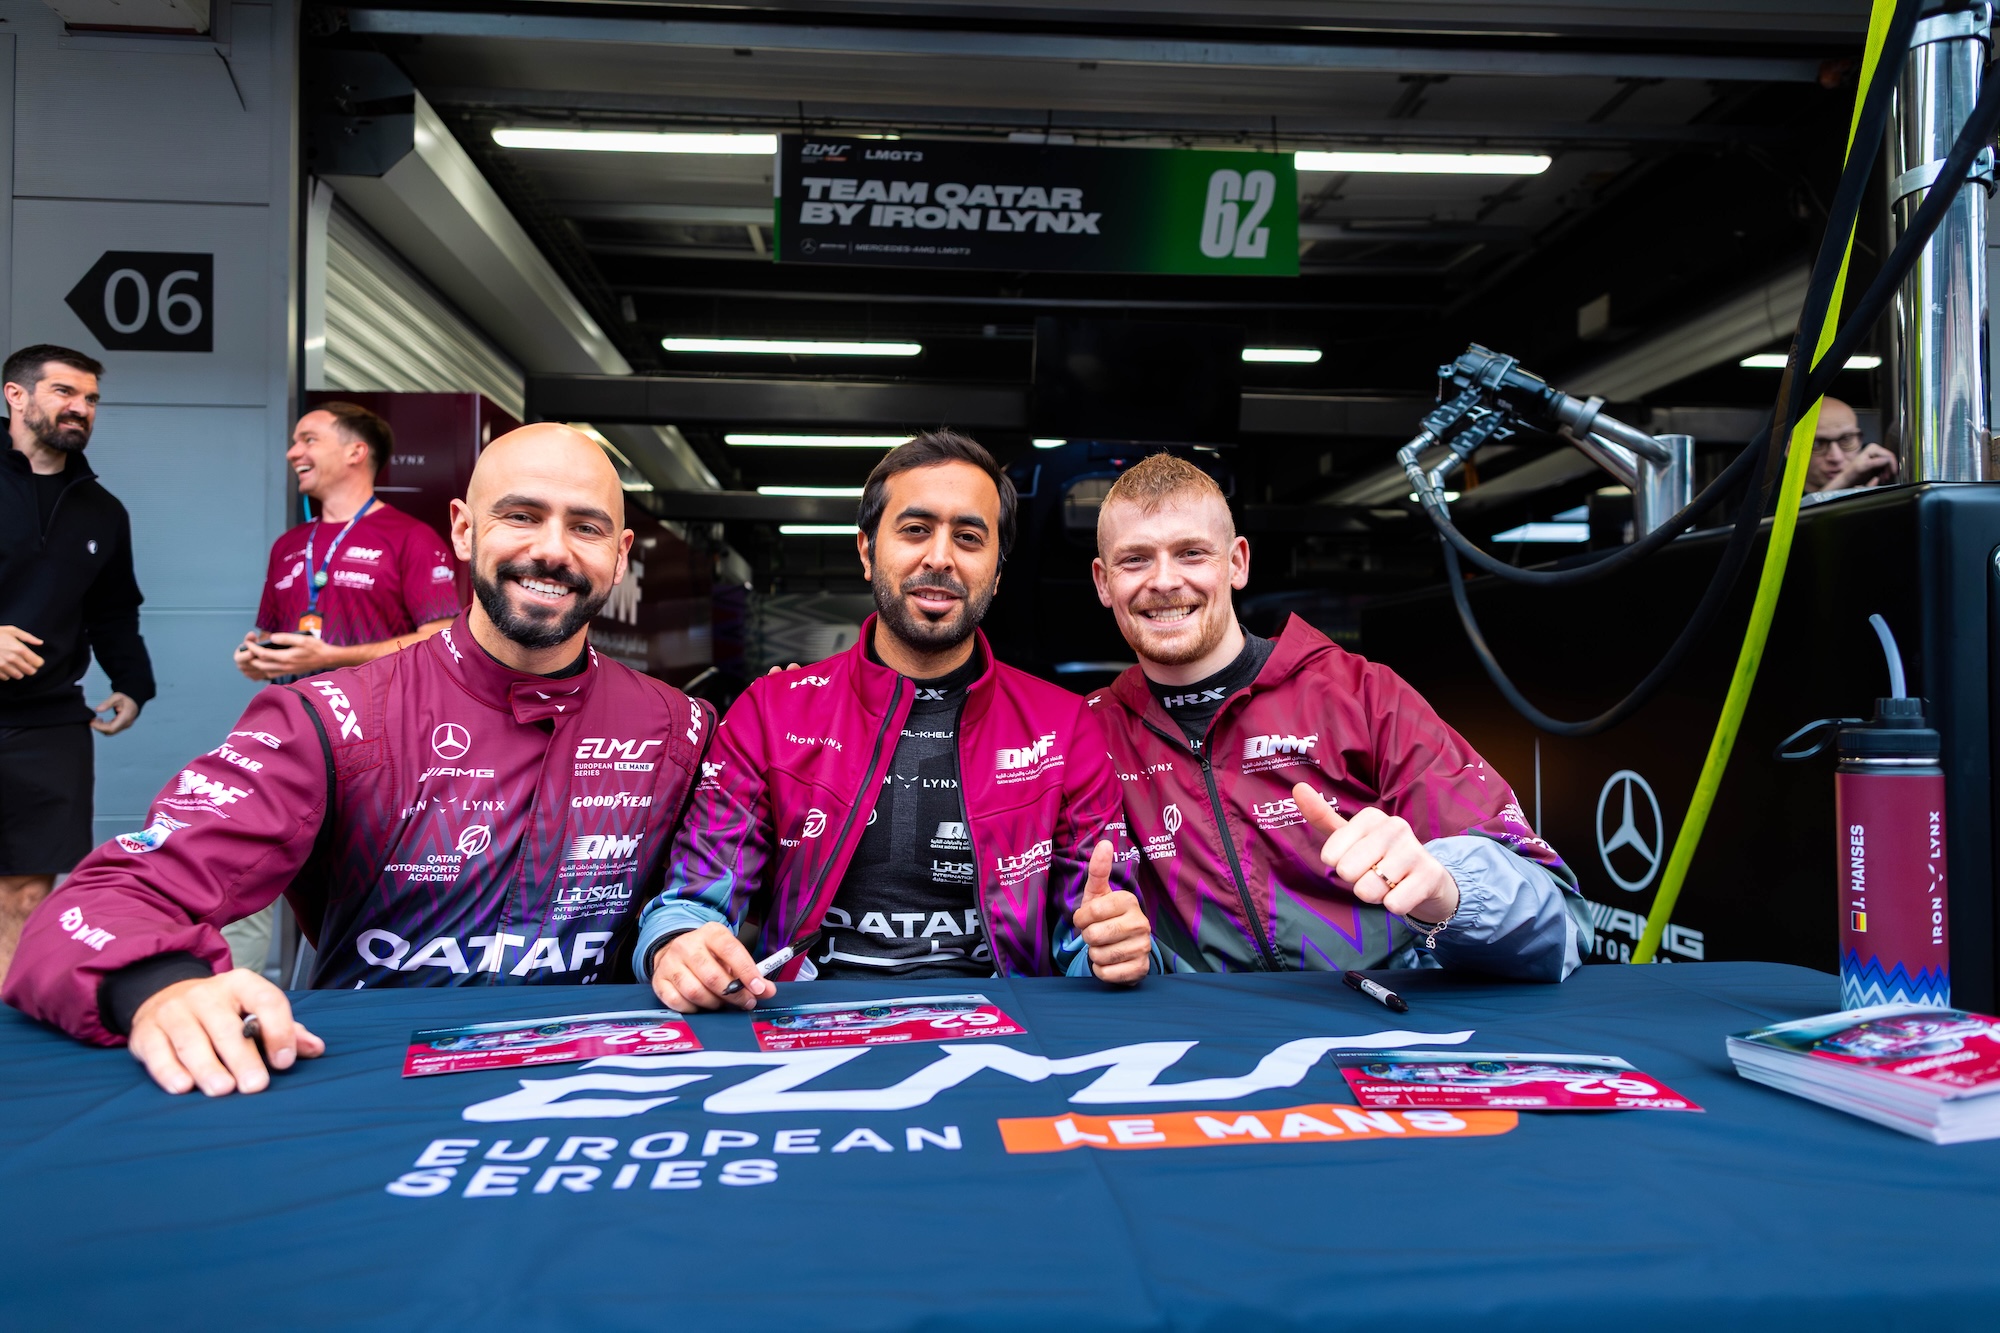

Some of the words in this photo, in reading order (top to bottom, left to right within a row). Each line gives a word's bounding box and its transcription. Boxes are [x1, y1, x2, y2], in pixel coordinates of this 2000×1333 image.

[865, 149, 924, 162] LMGT3
[802, 177, 929, 204] TEAM
[934, 183, 1083, 209] QATAR
[800, 201, 865, 225] BY
[869, 204, 982, 230] IRON
[987, 210, 1102, 234] LYNX
[1200, 169, 1276, 258] 62
[104, 268, 203, 335] 06
[391, 455, 425, 465] LYNX
[915, 689, 948, 700] RX
[1163, 687, 1226, 708] HRX
[310, 681, 363, 740] HRX
[786, 732, 815, 745] IRON
[432, 767, 494, 779] AMG
[574, 762, 613, 770] EUROPEAN
[923, 779, 958, 788] LYNX
[463, 801, 505, 811] LYNX
[1929, 811, 1941, 858] LYNX
[427, 854, 462, 864] QATAR
[1850, 824, 1866, 891] HANSES
[408, 873, 459, 882] ACADEMY
[932, 872, 973, 880] INTERNATIO
[553, 903, 605, 912] INTERNATIONAL
[1852, 897, 1866, 909] J.
[1932, 897, 1943, 945] IRON
[356, 929, 614, 977] QATAR
[930, 1012, 999, 1029] 62
[604, 1028, 681, 1045] 62
[1564, 1079, 1658, 1096] 62
[413, 1125, 962, 1168] EUROPEAN
[1054, 1117, 1166, 1144] LE
[1194, 1108, 1467, 1139] MANS
[385, 1159, 779, 1198] SERIES
